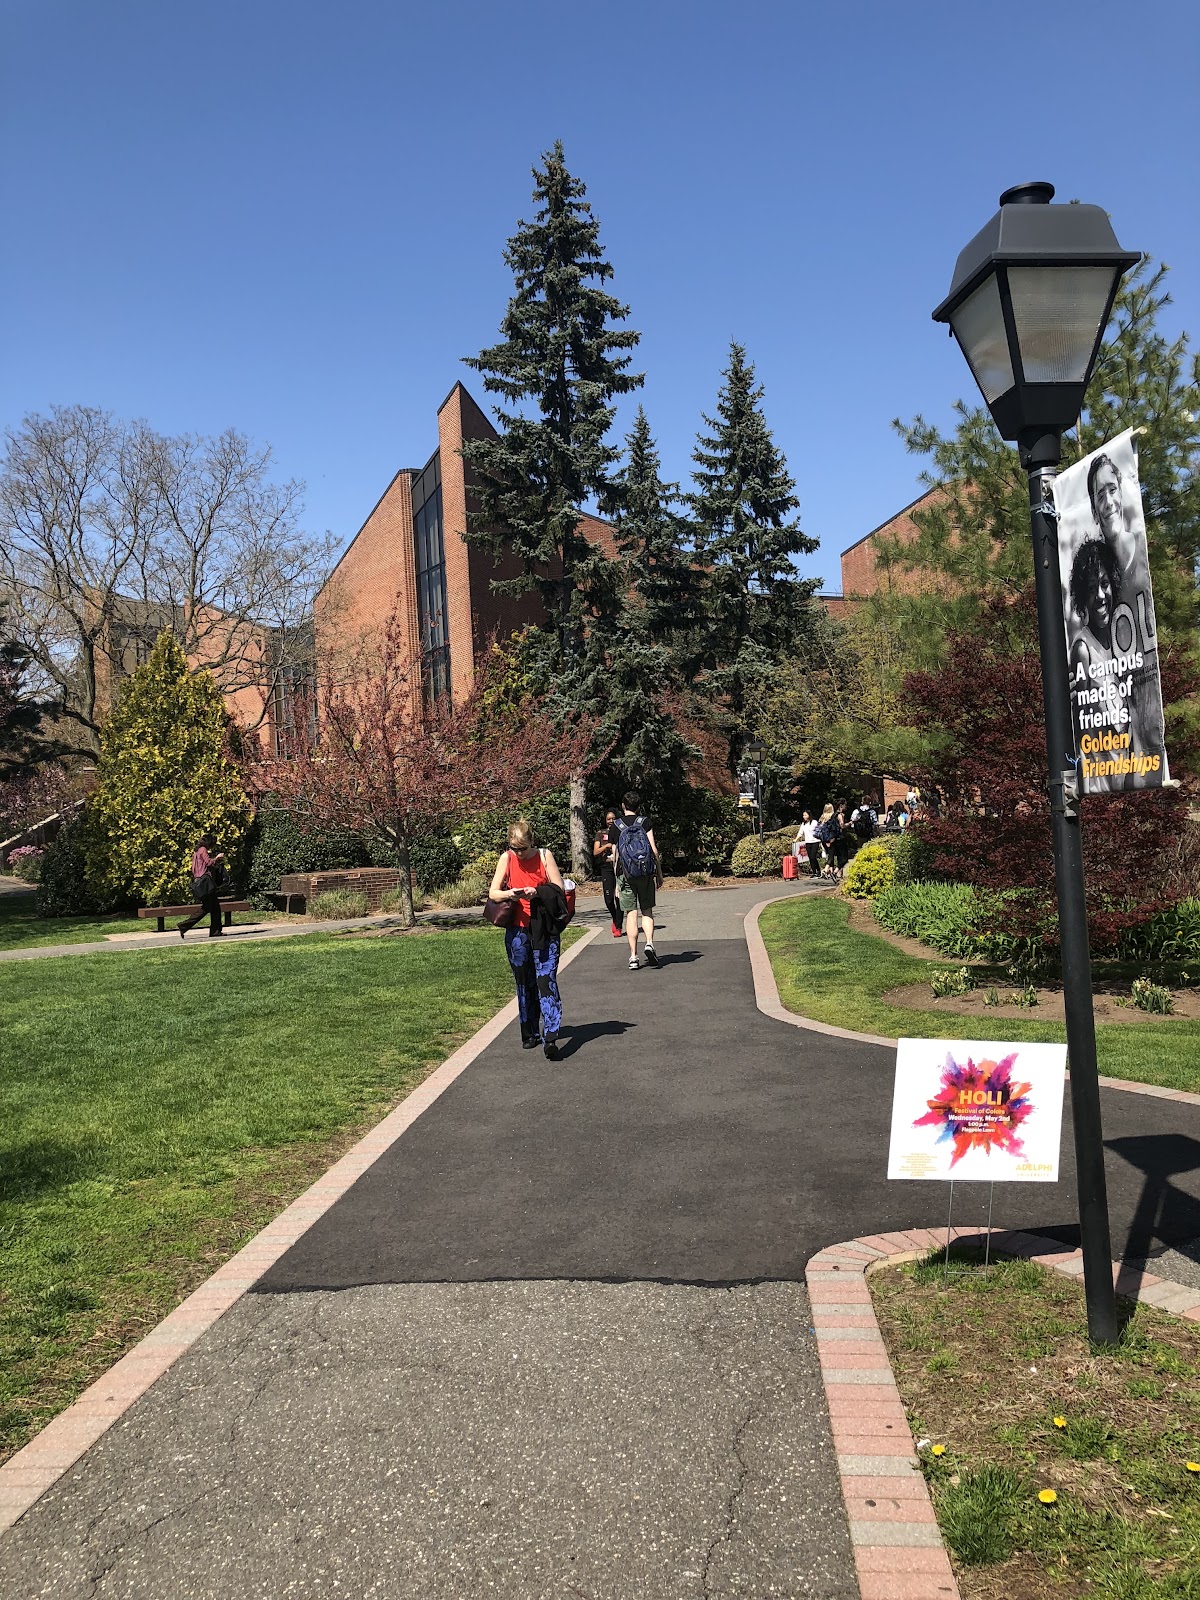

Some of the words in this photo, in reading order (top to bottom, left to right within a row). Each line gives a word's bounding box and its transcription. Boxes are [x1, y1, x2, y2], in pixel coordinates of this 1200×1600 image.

[1075, 662, 1086, 682] A
[1088, 651, 1144, 679] campus
[1077, 682, 1117, 706] made
[1118, 675, 1133, 698] of
[1078, 706, 1132, 730] friends.
[1081, 730, 1129, 754] Golden
[1082, 753, 1160, 778] Friendships
[959, 1090, 1002, 1105] HOLI
[948, 1114, 984, 1122] Wednesday,
[1015, 1163, 1052, 1171] ADELPHI
